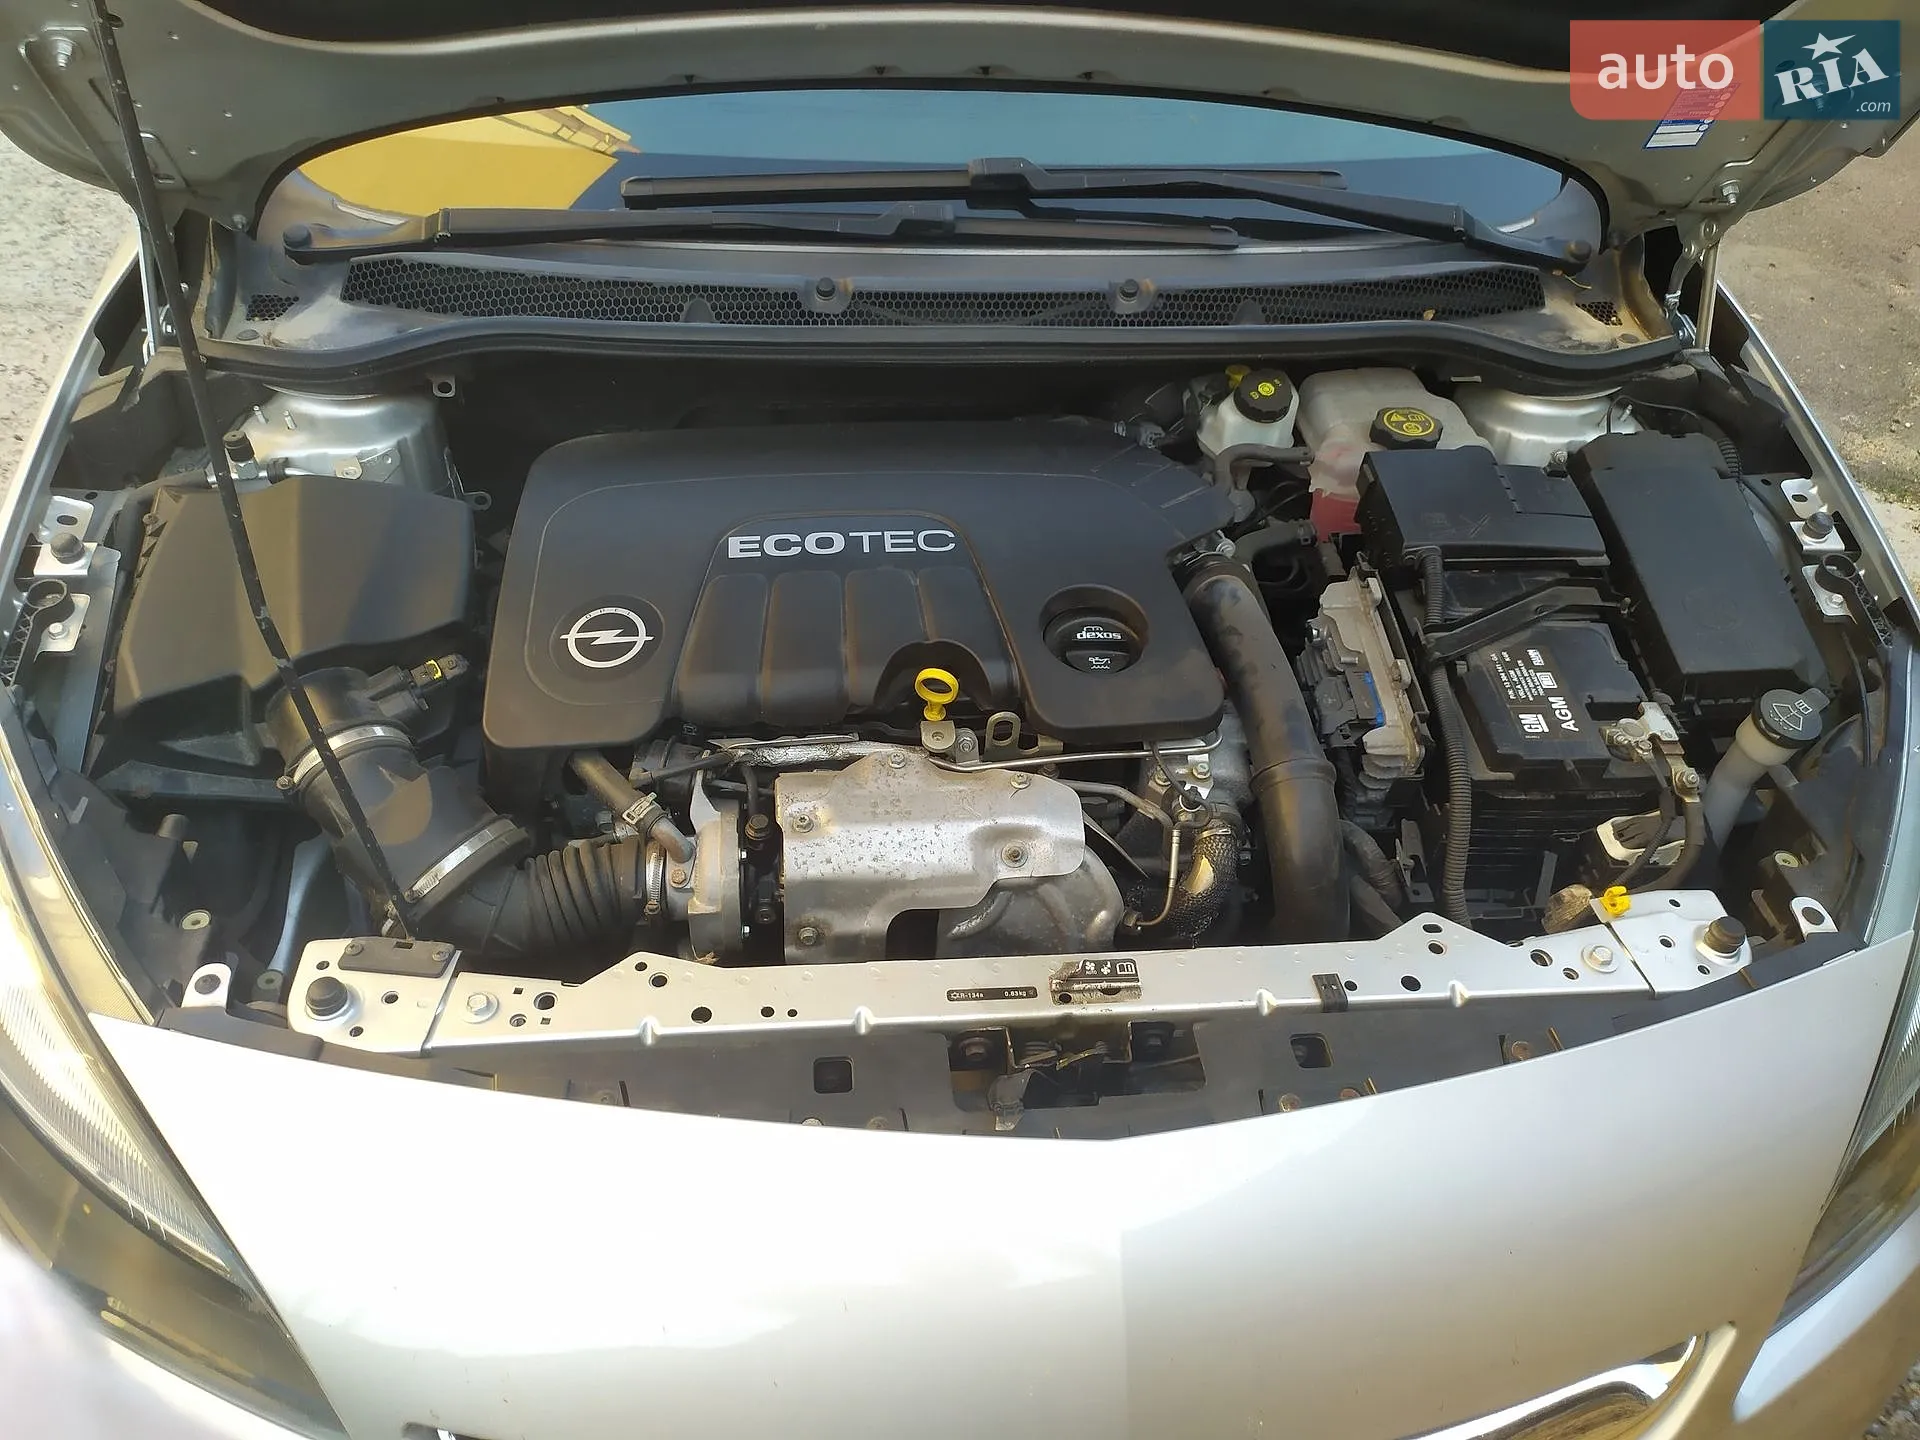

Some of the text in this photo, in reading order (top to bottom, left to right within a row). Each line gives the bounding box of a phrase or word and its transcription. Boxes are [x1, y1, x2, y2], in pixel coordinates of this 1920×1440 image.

[728, 529, 956, 559] ECOTEC
[1076, 630, 1122, 640] dexos
[1518, 713, 1544, 733] GM
[1547, 696, 1580, 732] AGM
